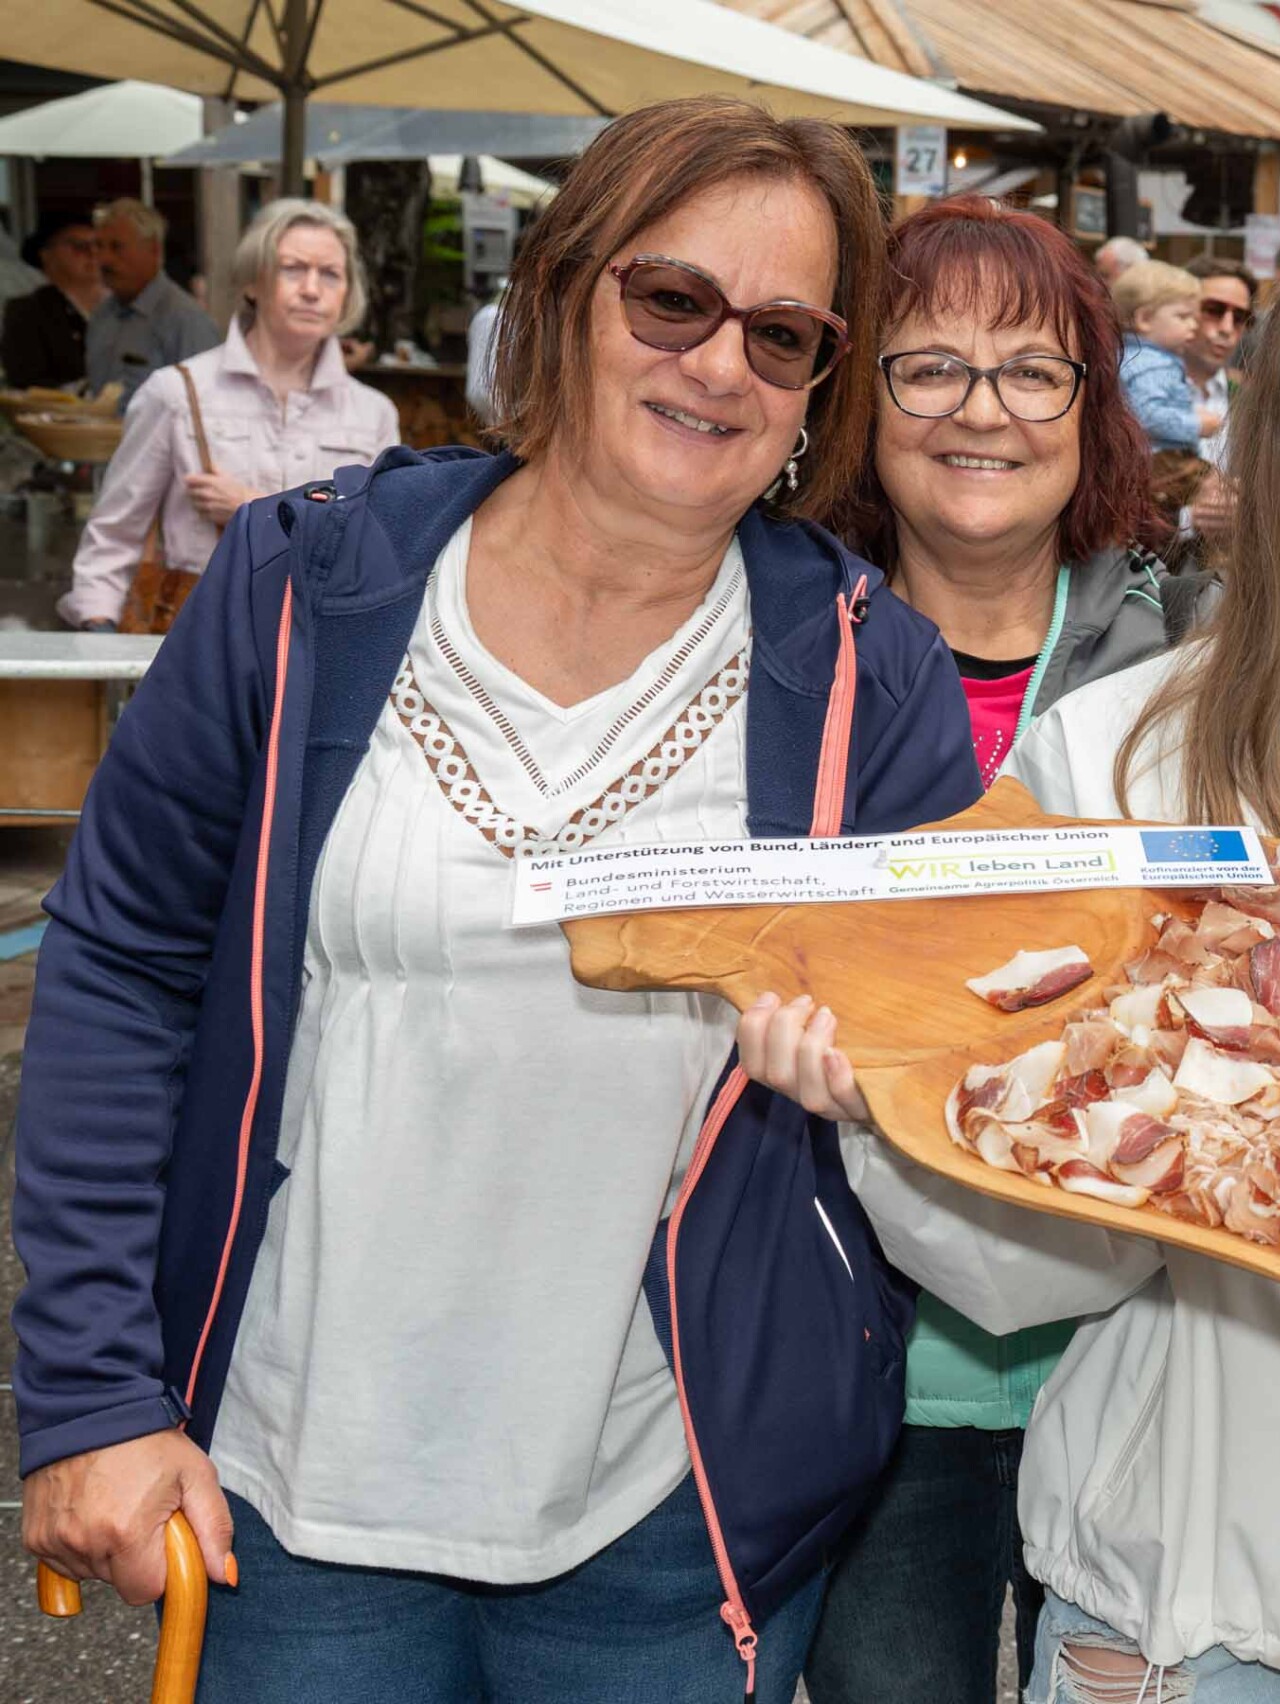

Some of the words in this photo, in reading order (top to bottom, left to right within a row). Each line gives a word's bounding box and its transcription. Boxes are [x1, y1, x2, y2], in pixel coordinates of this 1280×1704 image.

[906, 146, 937, 173] 27
[531, 860, 564, 871] Mit
[569, 845, 704, 866] Unterstützung
[710, 844, 744, 853] von
[750, 841, 804, 852] Bund,
[890, 836, 925, 847] und
[931, 832, 1050, 844] Europäischer
[1055, 831, 1109, 841] Union
[566, 865, 752, 887] Bundesministerium
[888, 863, 960, 879] WIR
[970, 859, 1036, 872] leben
[1045, 856, 1103, 869] Land
[1140, 865, 1214, 873] Kofinanziert
[1142, 872, 1224, 881] Europäischen
[1227, 872, 1264, 880] Union
[565, 885, 620, 900] Land-
[627, 881, 662, 892] und
[670, 875, 827, 889] Forstwirtschaft,
[889, 883, 970, 893] Gemeinsame
[974, 879, 1048, 889] Agrarpolitik
[1053, 874, 1119, 885] Österreich
[564, 895, 653, 913] Regionen
[661, 891, 697, 902] und
[704, 886, 876, 900] Wasserwirtschaft
